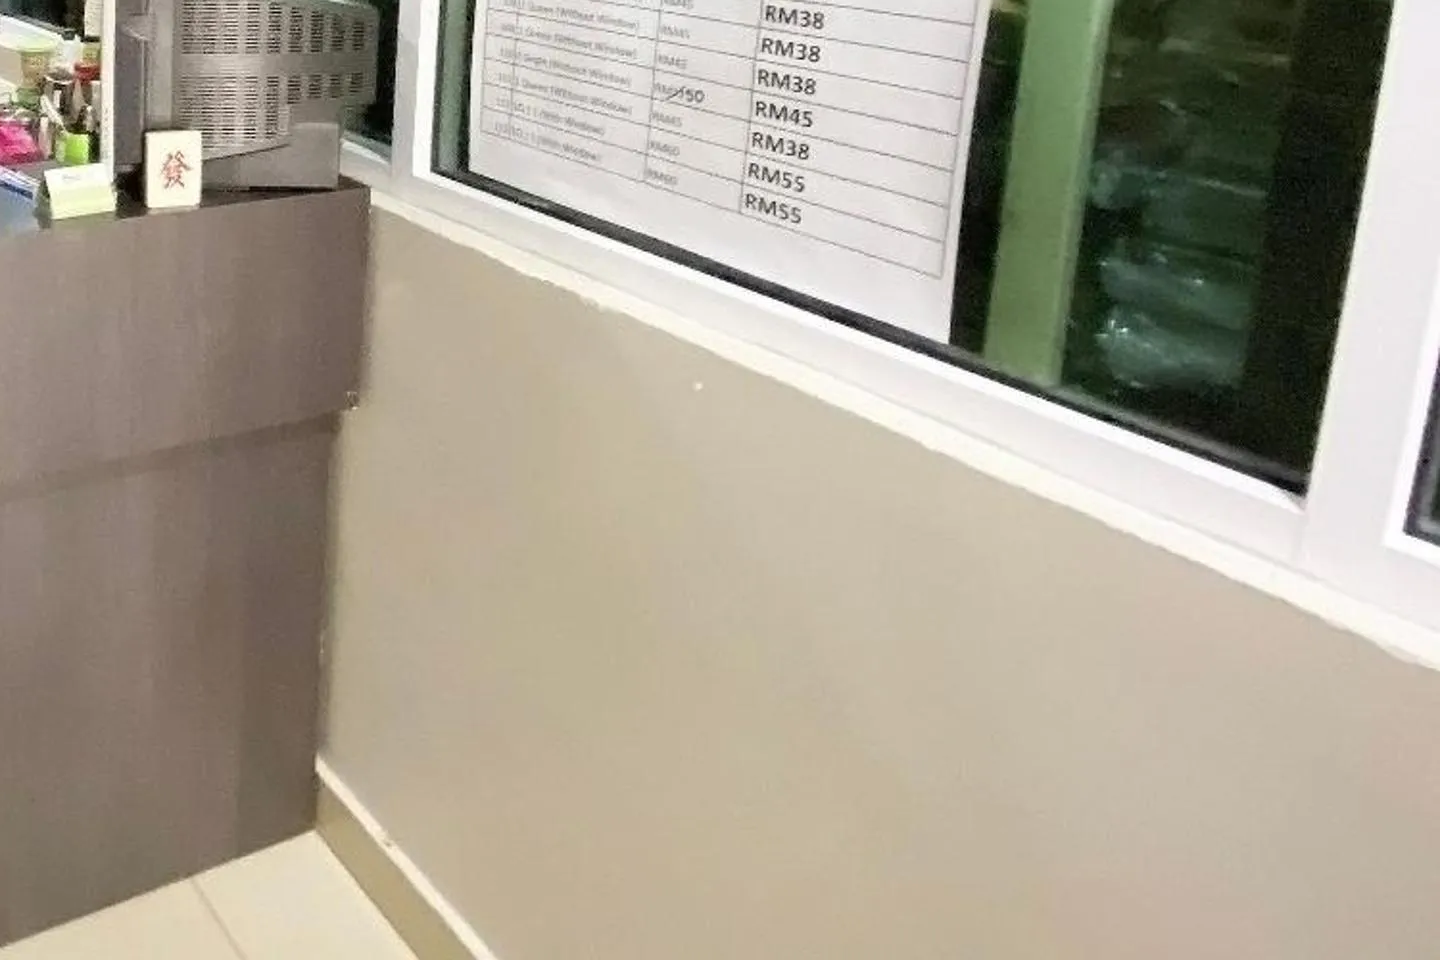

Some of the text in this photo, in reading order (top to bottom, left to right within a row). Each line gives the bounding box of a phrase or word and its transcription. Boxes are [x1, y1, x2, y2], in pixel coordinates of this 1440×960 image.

[765, 5, 825, 30] RM38
[761, 38, 821, 62] RM38
[757, 69, 817, 95] RM38
[755, 101, 813, 128] RM45
[751, 131, 810, 160] RM38
[748, 162, 806, 193] RM55
[744, 193, 802, 224] RM55
